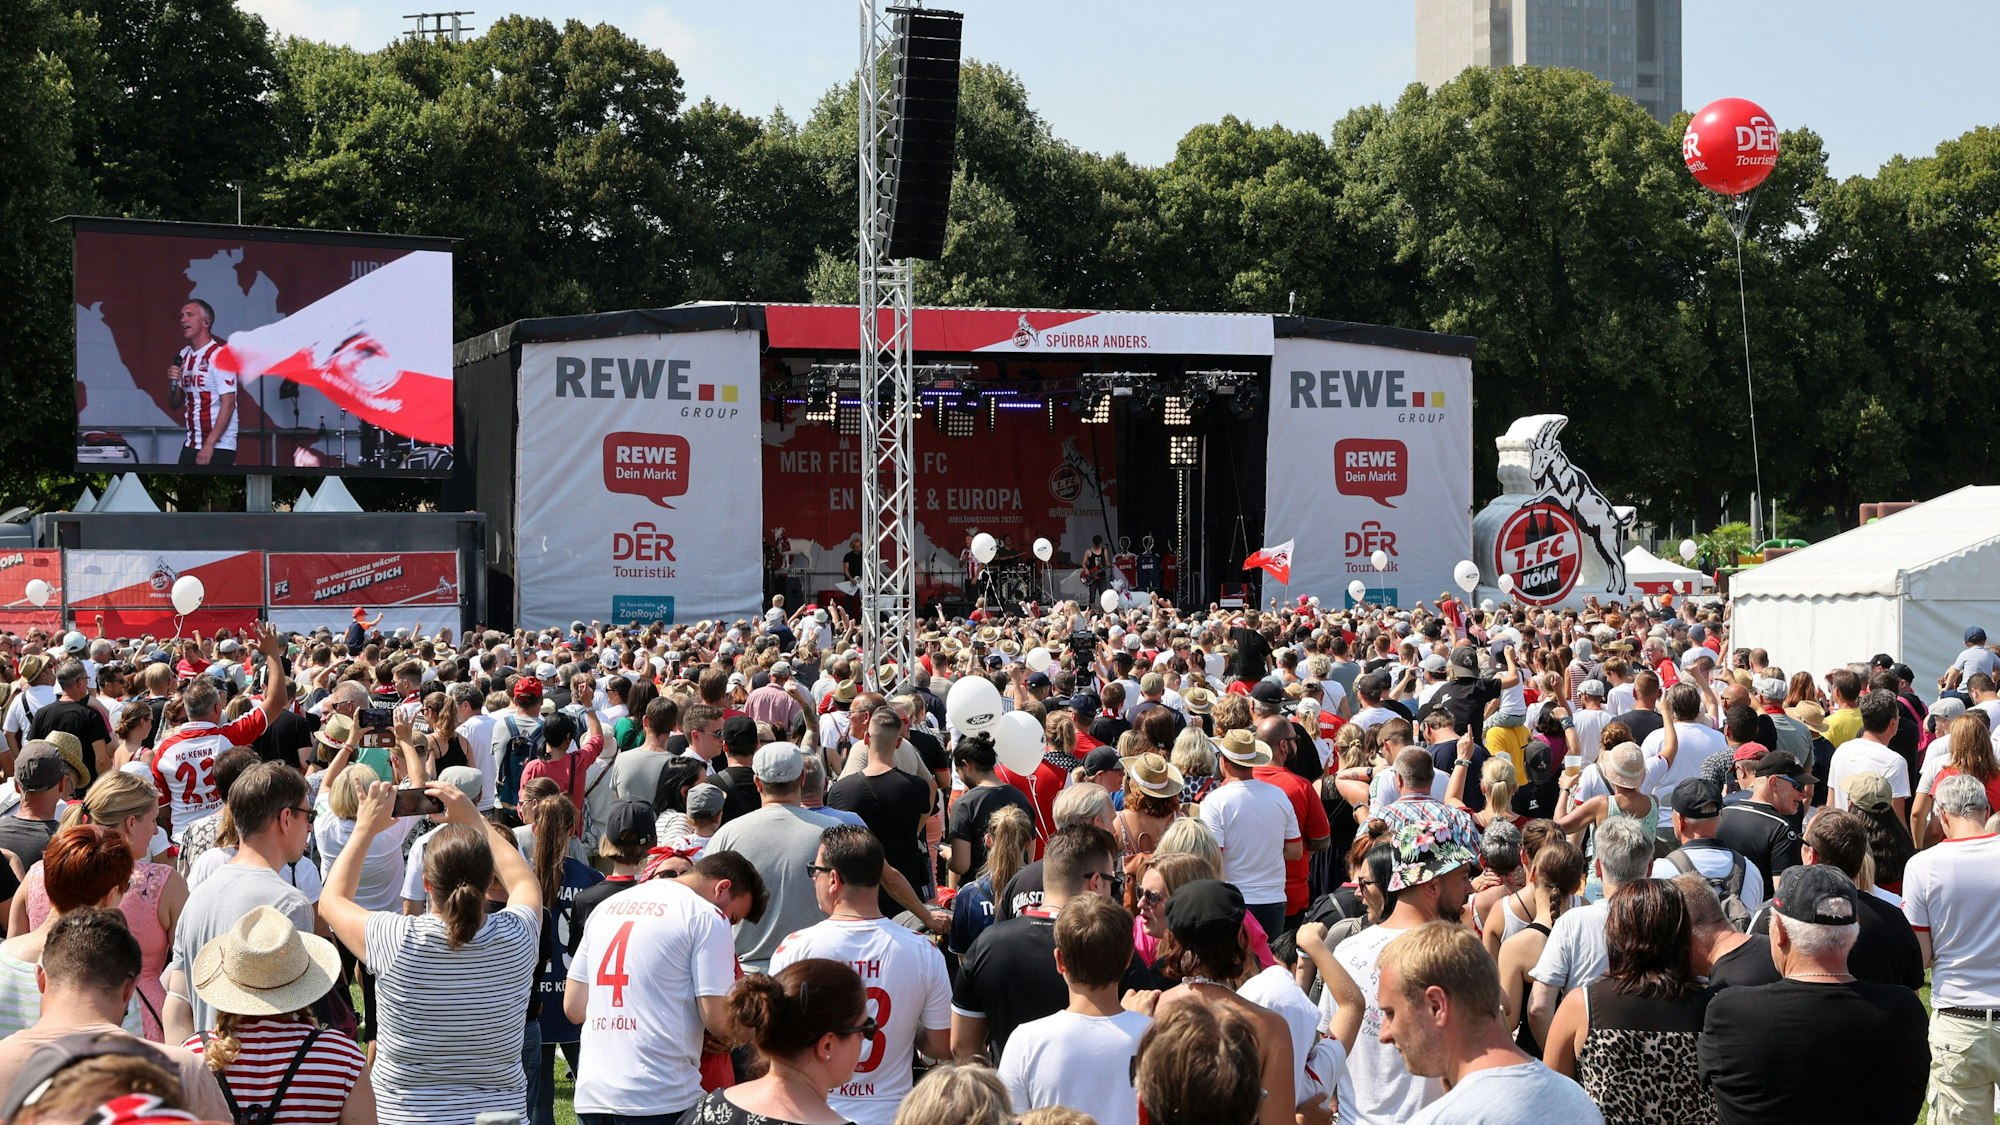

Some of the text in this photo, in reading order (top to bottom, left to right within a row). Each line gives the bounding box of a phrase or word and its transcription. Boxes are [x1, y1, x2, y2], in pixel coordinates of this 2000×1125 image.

[1046, 332, 1151, 349] SPÜRBAR ANDERS.
[555, 356, 692, 400] REWE
[1290, 370, 1407, 409] REWE
[680, 406, 739, 419] GROUP
[1398, 413, 1446, 423] GROUP
[616, 445, 677, 464] REWE
[780, 452, 822, 473] MER
[924, 452, 948, 474] FC
[1345, 451, 1397, 468] REWE
[615, 466, 677, 480] Dein Markt
[1345, 470, 1397, 482] Dein Markt
[829, 488, 855, 510] EN
[926, 488, 940, 511] &
[947, 488, 1023, 511] EUROPA
[613, 532, 676, 562] DER
[1345, 532, 1398, 557] DER
[316, 555, 401, 585] DIE VORFREUDE WÄCHST
[613, 565, 676, 578] Touristik
[1521, 564, 1559, 591] KÖLN
[314, 566, 402, 600] AUCH AUF DICH
[619, 608, 663, 620] ZooRoyal
[175, 748, 213, 761] MC KENNA
[605, 899, 668, 917] HÜBERS
[597, 920, 635, 1007] 4
[611, 1015, 637, 1031] KÖLN
[840, 1081, 875, 1096] KÖLN
